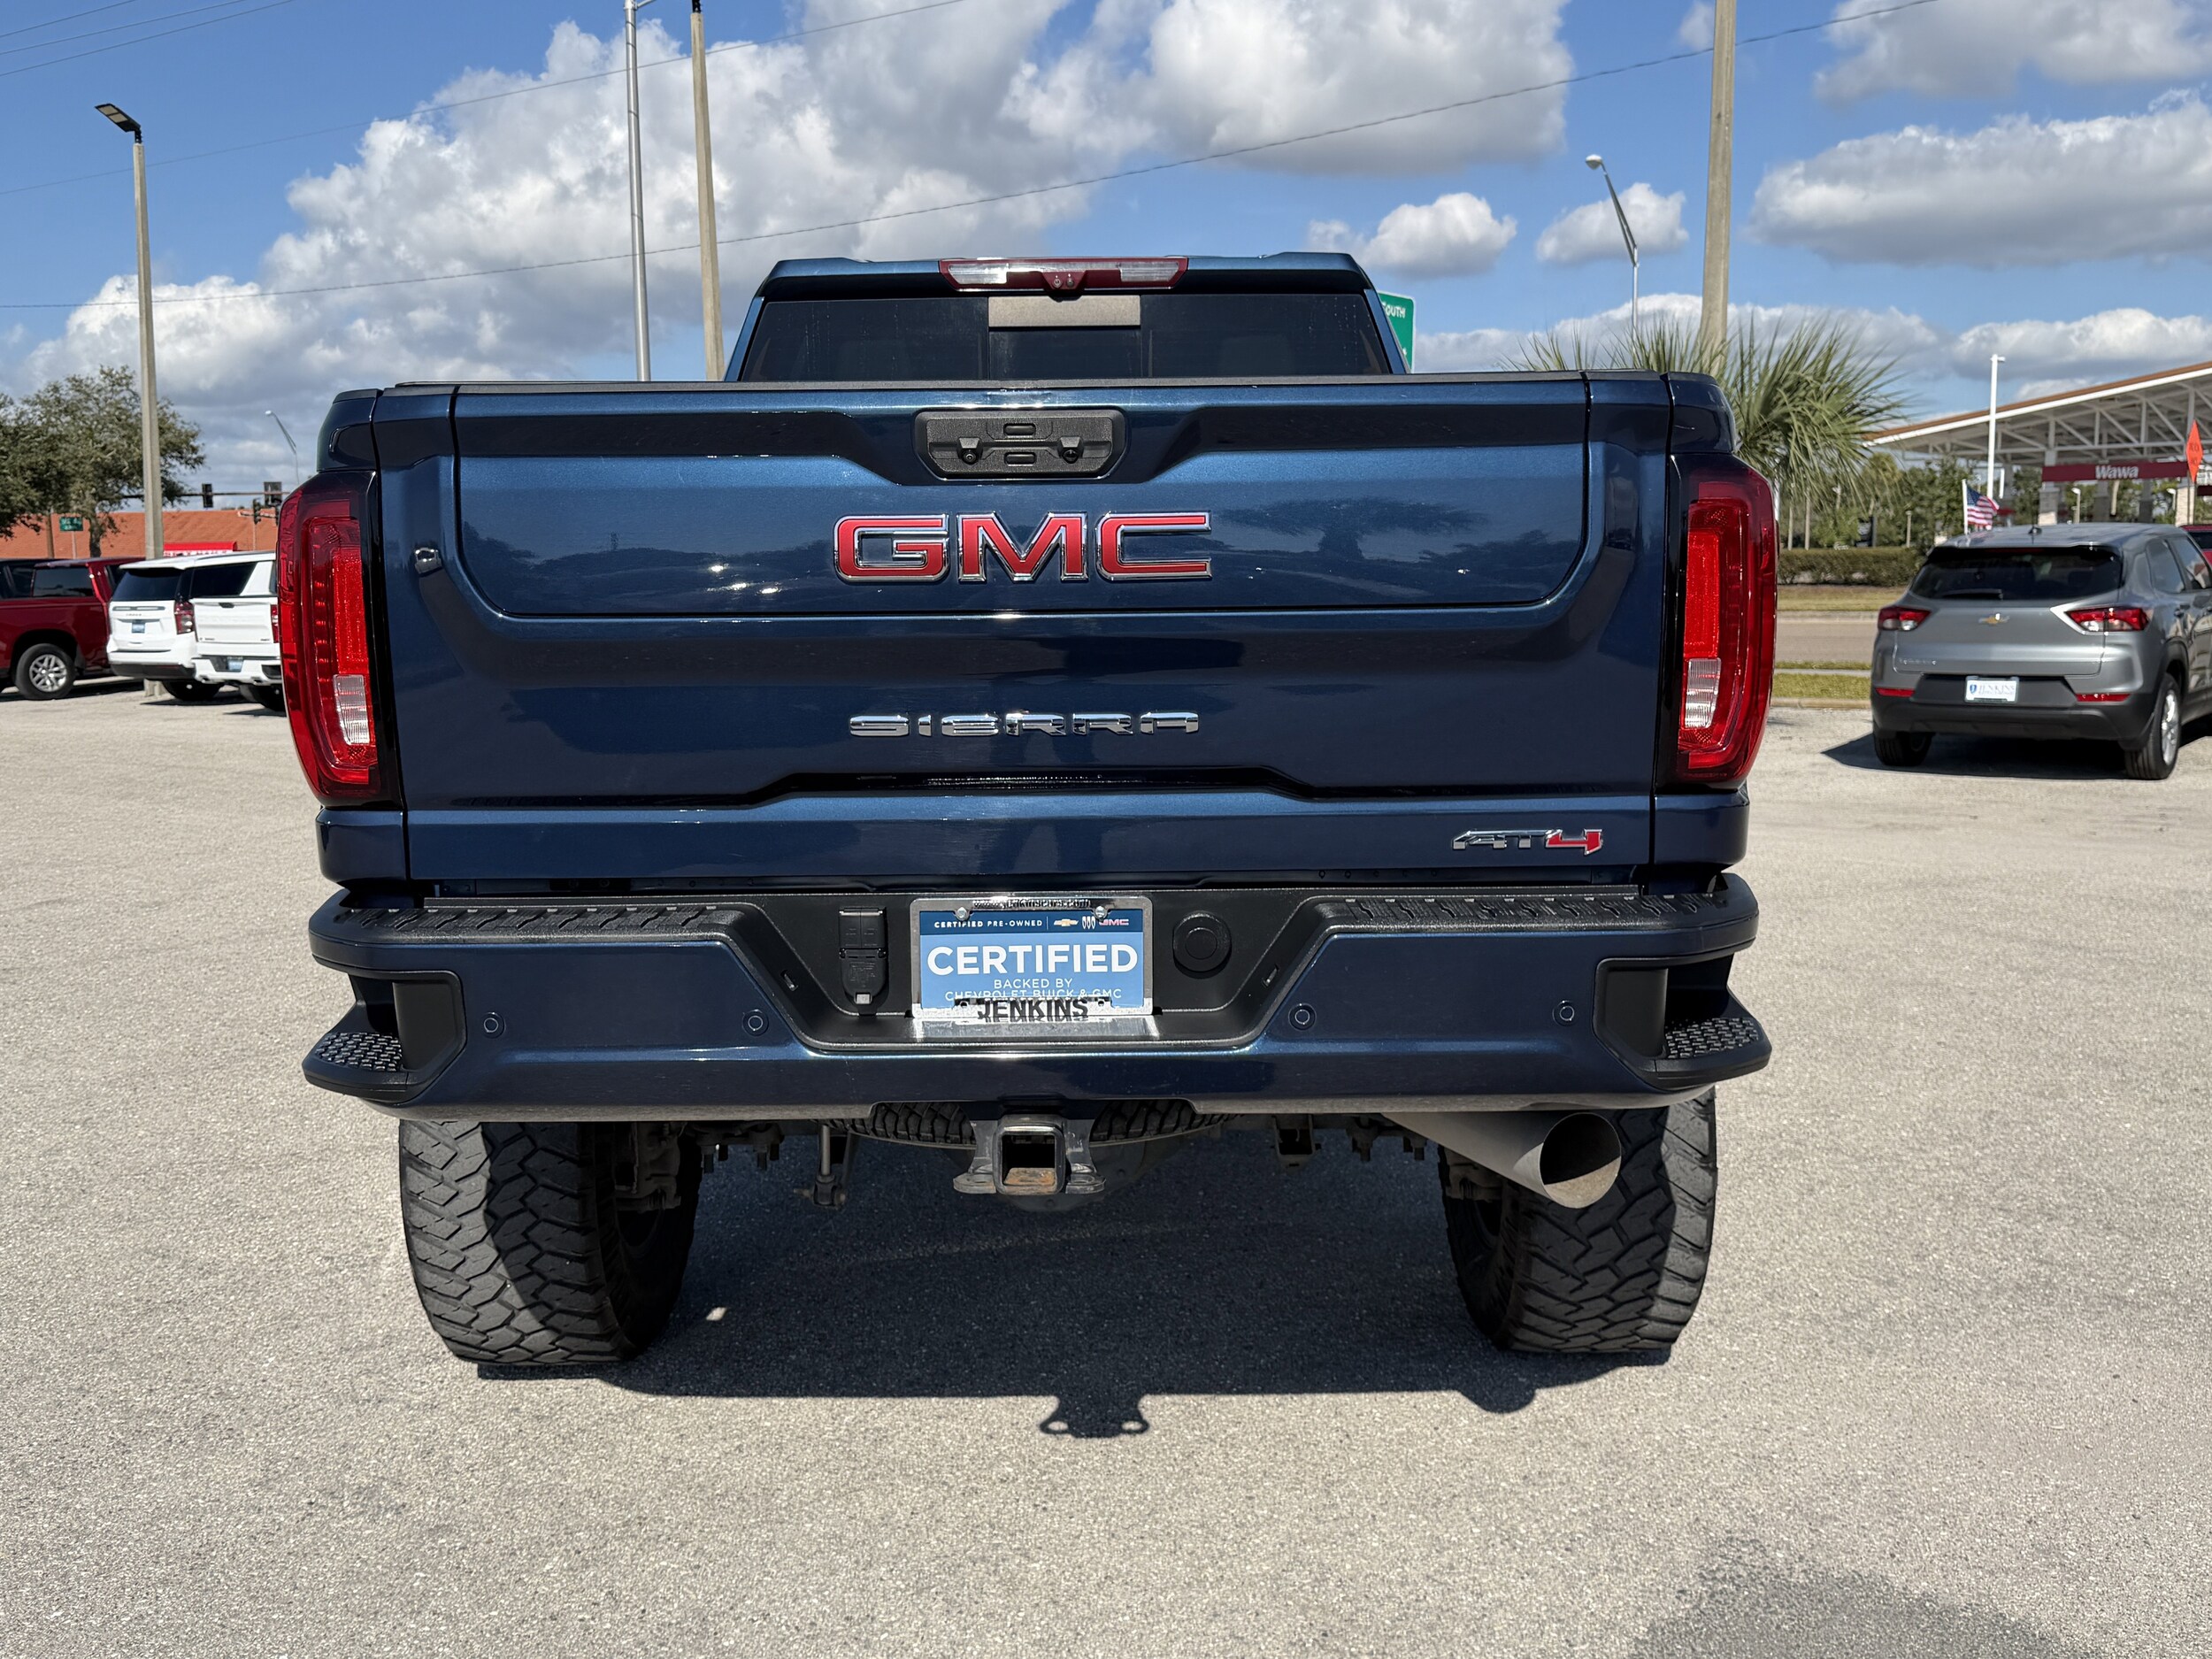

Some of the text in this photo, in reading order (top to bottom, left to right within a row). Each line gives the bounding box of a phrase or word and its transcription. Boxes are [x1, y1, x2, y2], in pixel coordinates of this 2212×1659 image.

[2095, 465, 2139, 479] Wawa
[834, 511, 1212, 582] GMC
[850, 711, 1199, 737] SIERRA
[1453, 829, 1603, 855] AT4
[927, 944, 1138, 976] CERTIFIED
[945, 990, 1027, 1001] CHEVROLET
[1033, 989, 1074, 998] BUICK
[1092, 988, 1122, 999] GMC
[994, 978, 1073, 989] BACKED BY
[978, 997, 1089, 1018] JENKINS
